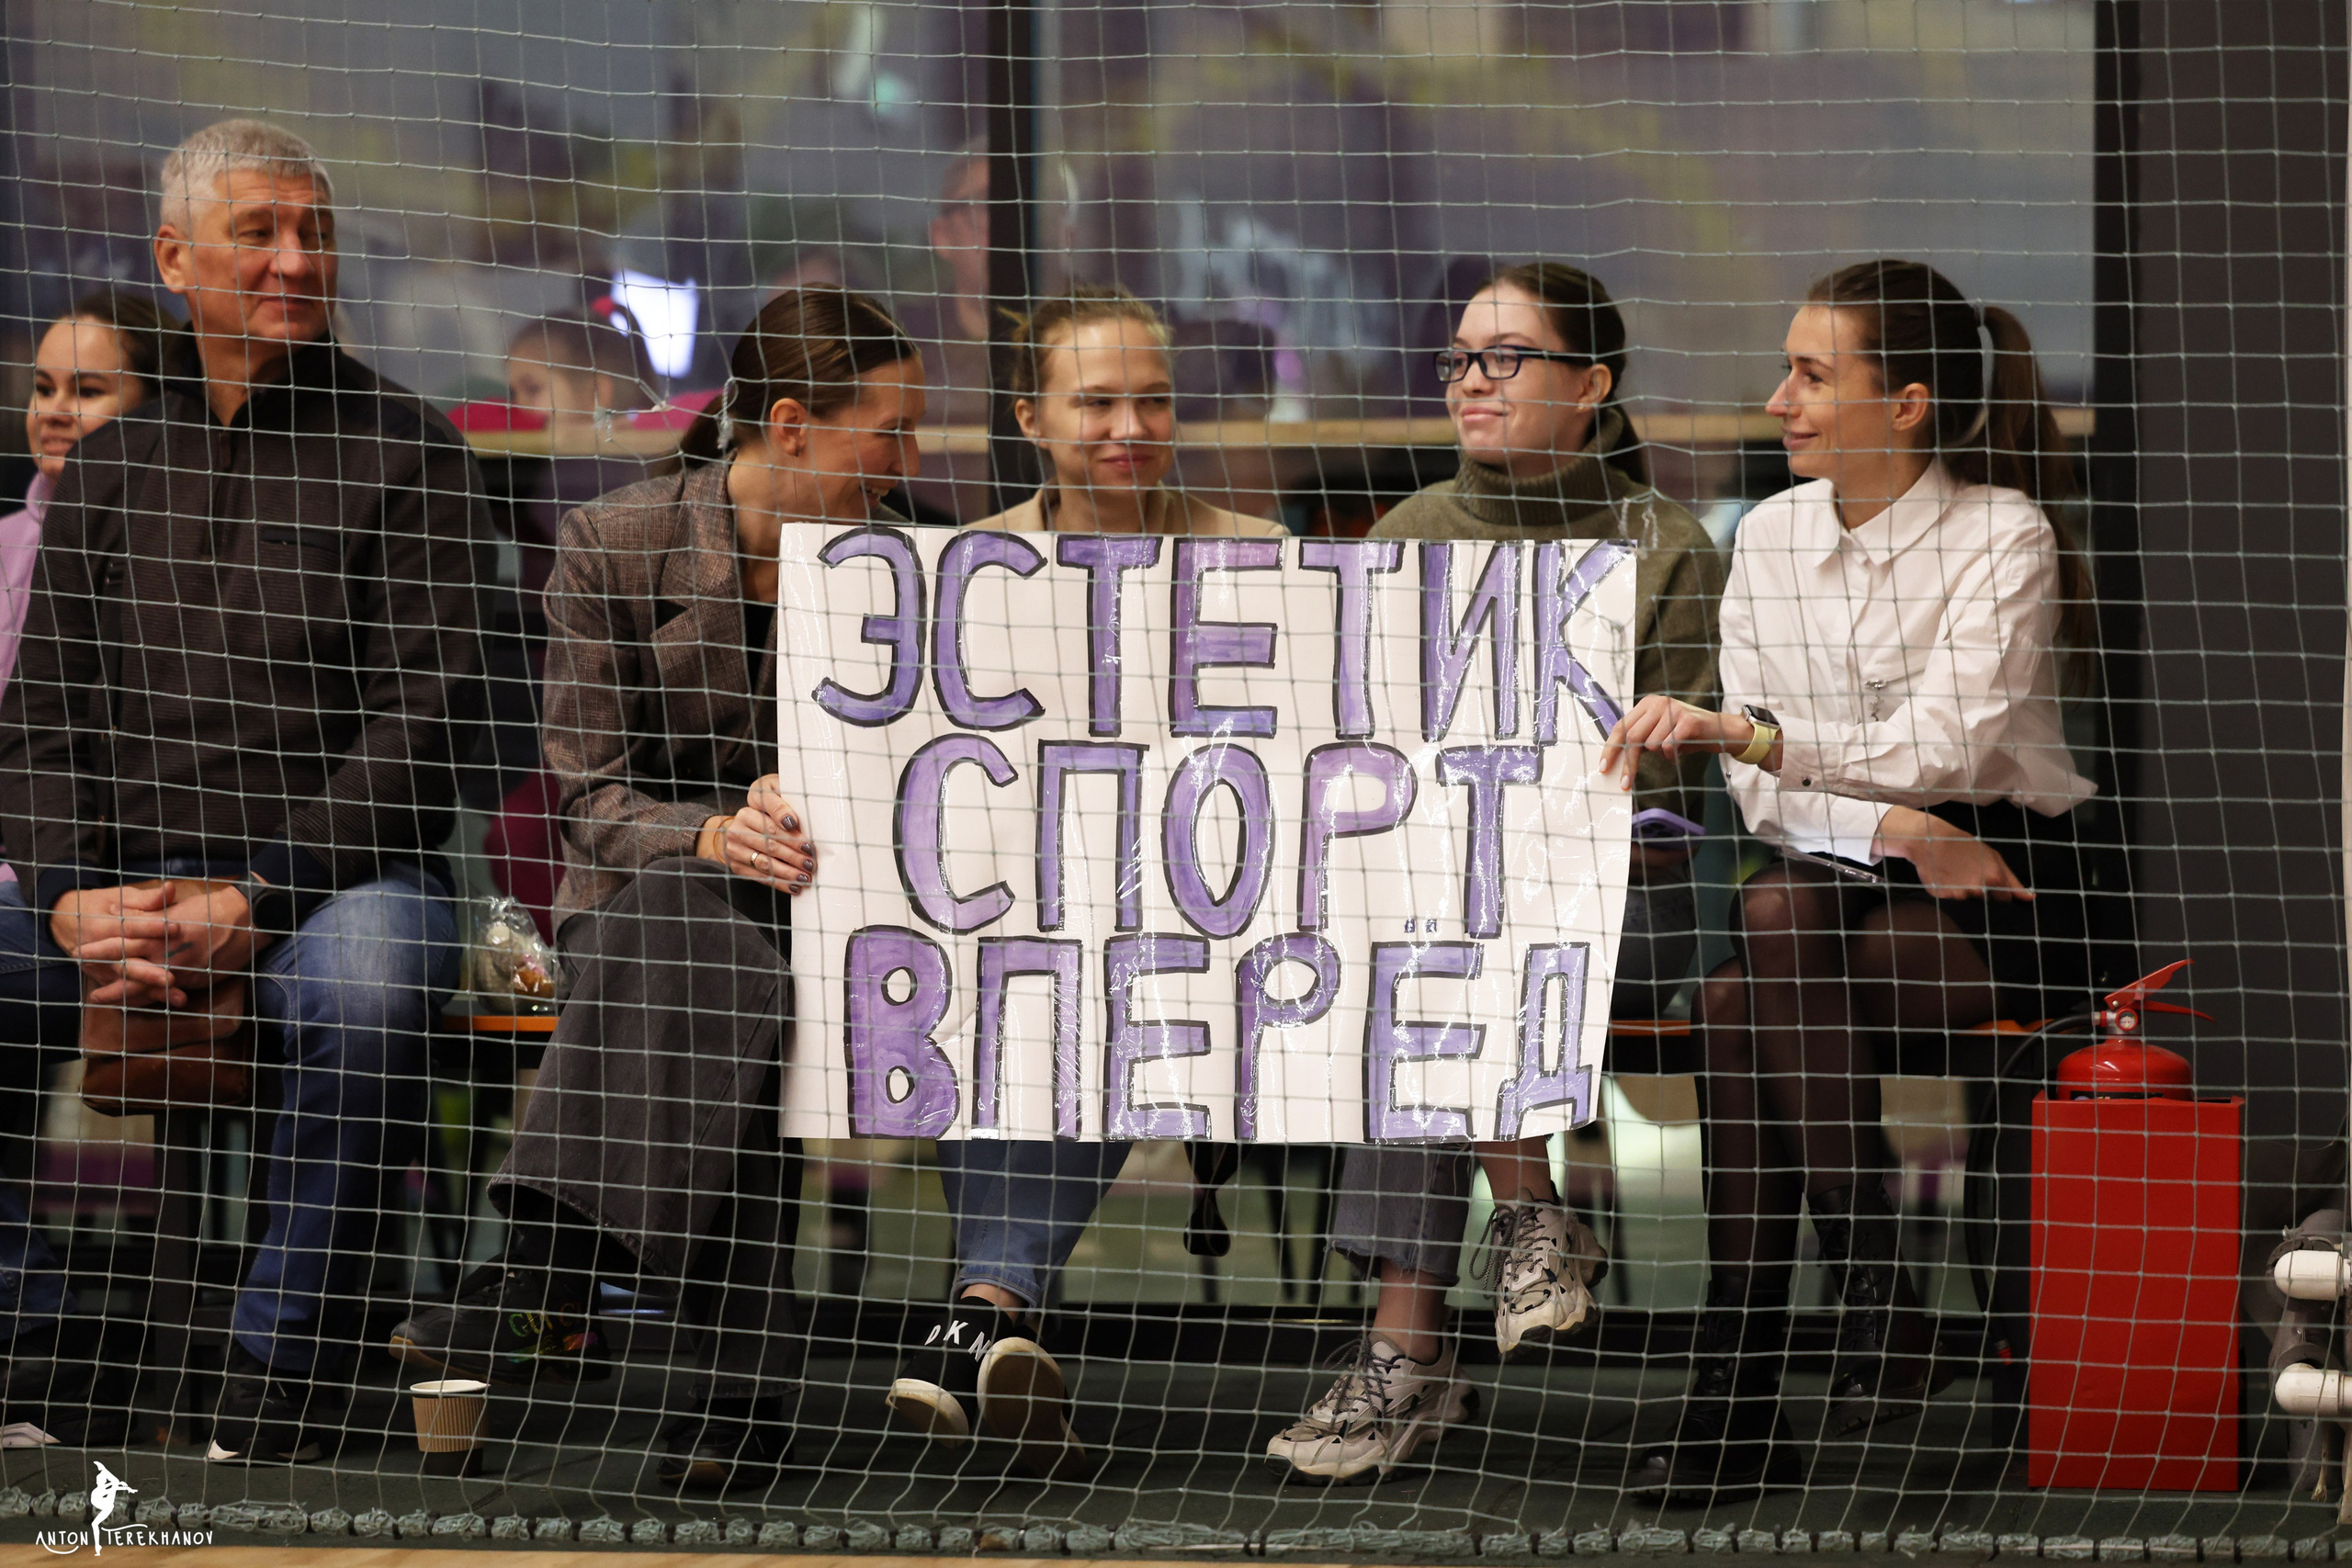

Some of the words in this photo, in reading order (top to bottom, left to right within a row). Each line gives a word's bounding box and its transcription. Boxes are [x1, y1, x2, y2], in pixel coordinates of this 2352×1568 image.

[812, 525, 1636, 744] ЭСТЕТИК
[893, 734, 1543, 940] СПОРТ
[844, 920, 1591, 1144] ВПЕРЁД
